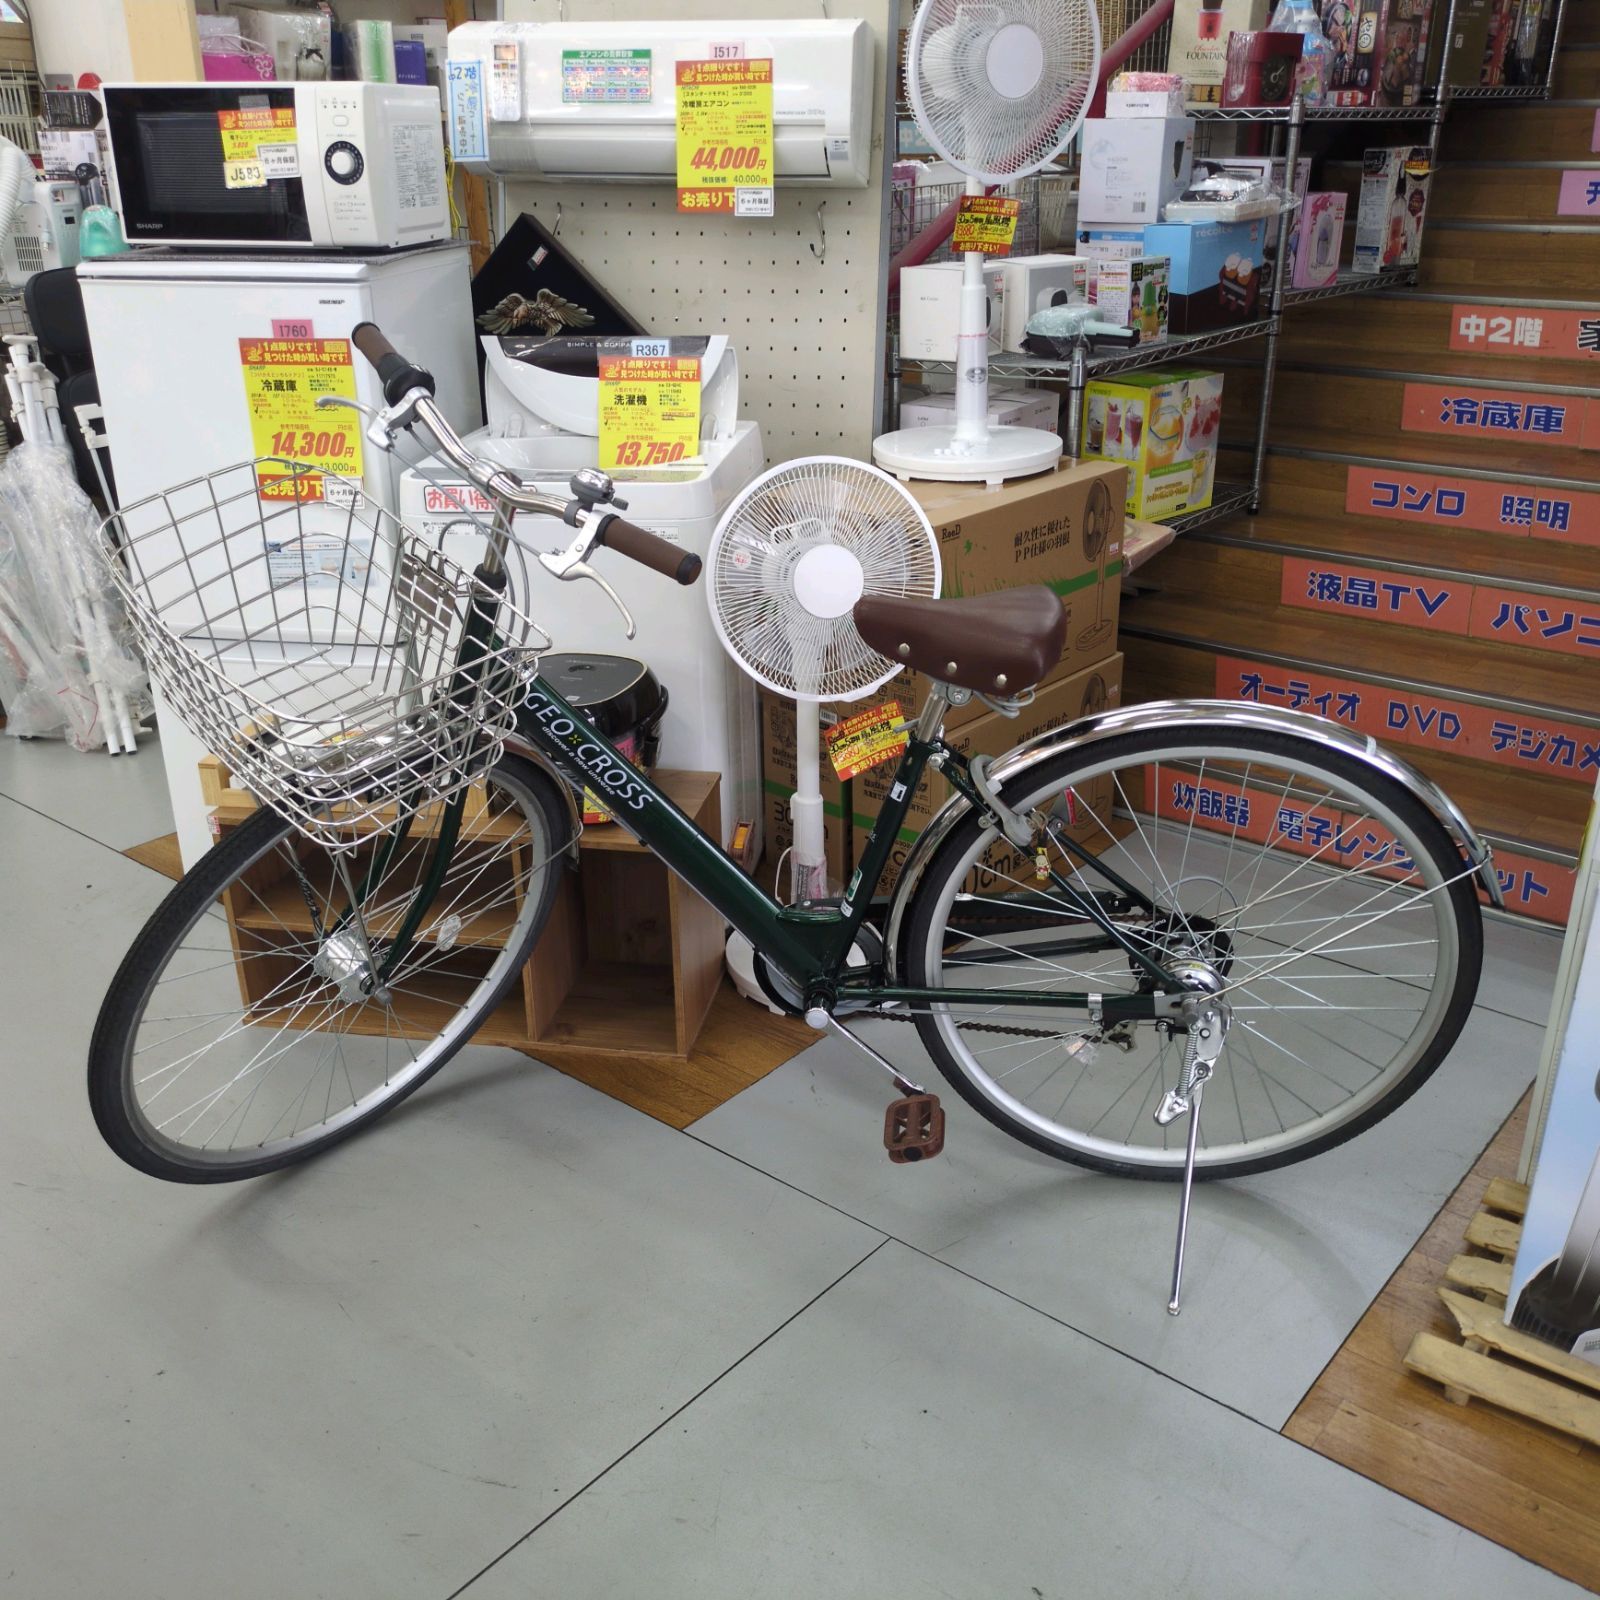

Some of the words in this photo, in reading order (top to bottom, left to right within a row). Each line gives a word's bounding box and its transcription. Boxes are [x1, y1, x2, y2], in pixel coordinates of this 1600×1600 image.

[714, 46, 739, 59] I517
[1459, 314, 1543, 347] 中2階
[636, 344, 666, 356] R367
[262, 379, 297, 392] 冷蔵庫
[613, 394, 647, 406] 洗濯機
[1440, 398, 1566, 433] 冷蔵庫
[616, 441, 692, 466] 13,750
[427, 487, 499, 510] お買い得
[1371, 481, 1466, 518] コンロ
[1500, 495, 1571, 531] 照明
[1014, 515, 1070, 548] 耐久性に優れた
[1306, 571, 1450, 617] 液晶TV
[1240, 673, 1360, 722] オーディオ
[1387, 701, 1462, 740] DVD
[523, 692, 575, 736] GEO
[577, 744, 654, 810] CROSS
[1173, 780, 1250, 828] 炊飯器
